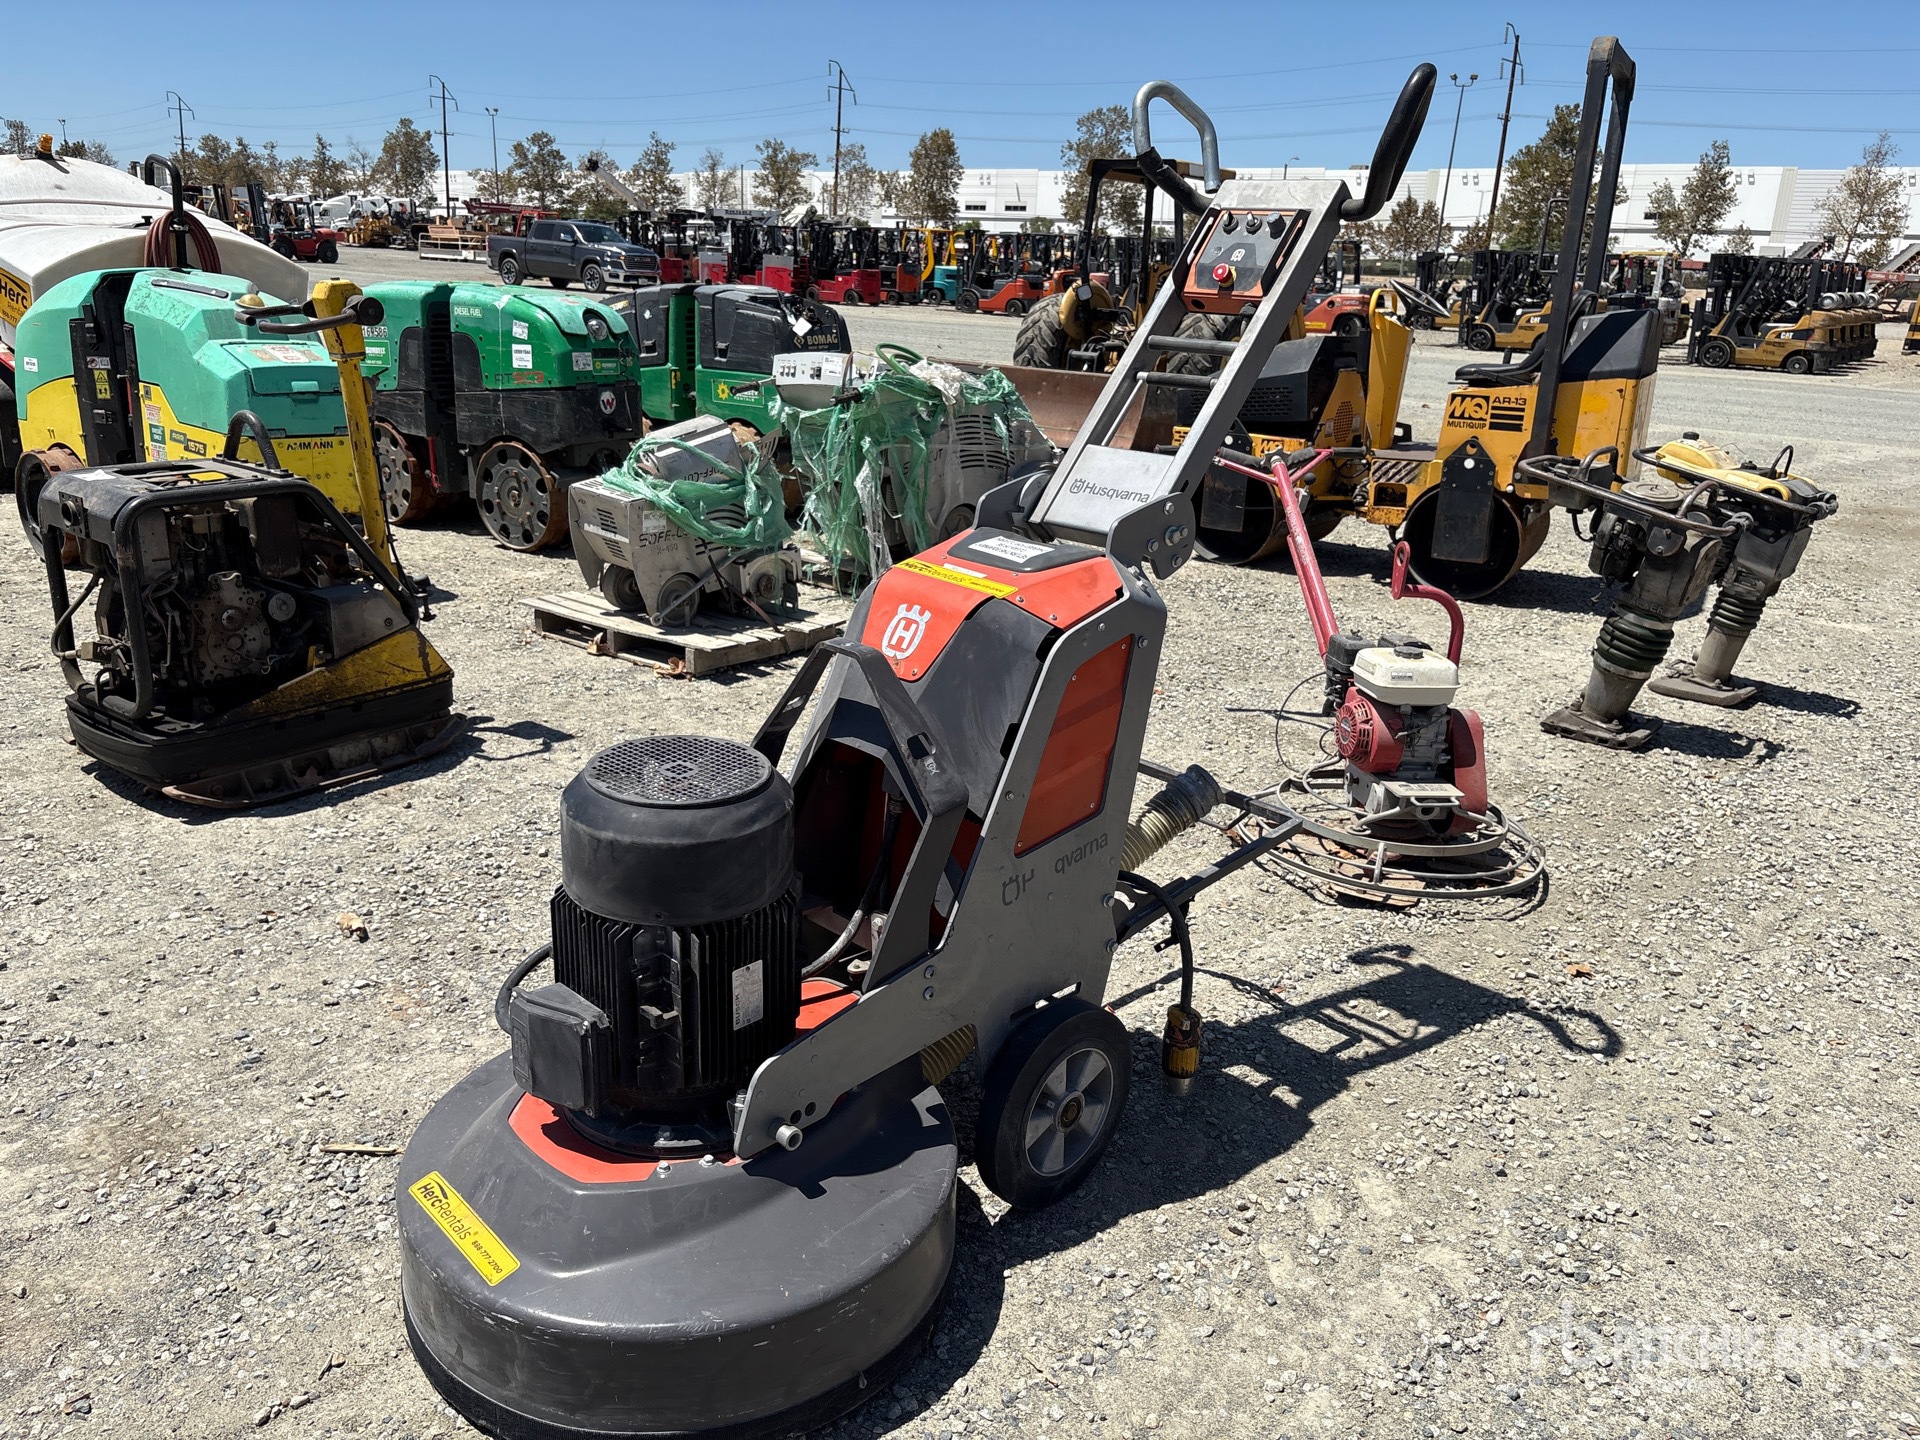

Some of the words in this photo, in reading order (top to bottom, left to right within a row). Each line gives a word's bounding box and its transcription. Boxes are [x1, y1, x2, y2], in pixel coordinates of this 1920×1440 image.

[454, 306, 470, 316] DIESEL
[470, 308, 482, 317] FUEL
[1530, 316, 1541, 324] CAT
[806, 333, 838, 346] BOMAG
[1780, 331, 1794, 339] CAT
[1492, 396, 1527, 406] AR-13
[1449, 396, 1489, 420] MQ
[1447, 420, 1487, 430] MULTIQUIP
[188, 441, 204, 453] 1575
[1082, 481, 1151, 503] Husqvarna
